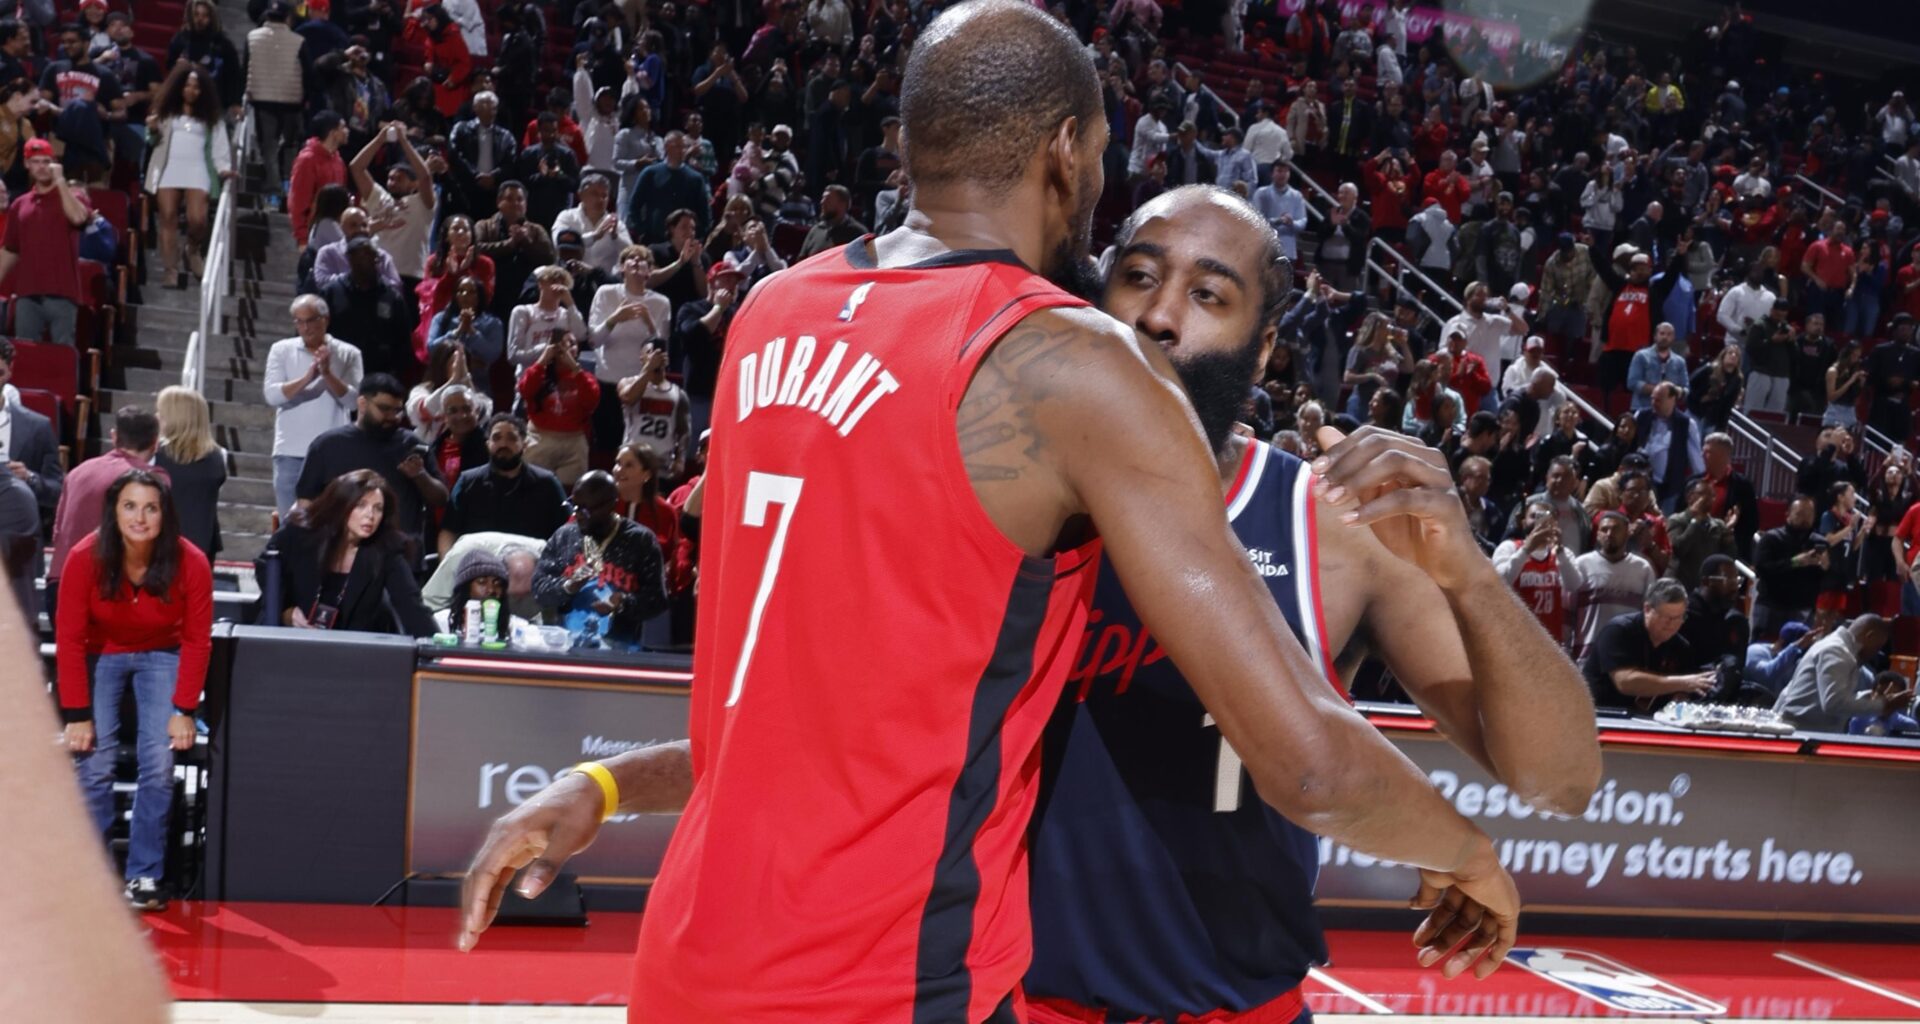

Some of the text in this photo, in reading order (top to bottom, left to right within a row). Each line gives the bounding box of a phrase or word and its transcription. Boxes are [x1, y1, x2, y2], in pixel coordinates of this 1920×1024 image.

[737, 335, 900, 438] DURANT
[640, 415, 668, 440] 28
[1246, 548, 1273, 564] SIT
[1254, 561, 1289, 577] NDA
[723, 470, 805, 707] 7
[1622, 837, 1752, 881] starts
[1757, 837, 1864, 885] here.
